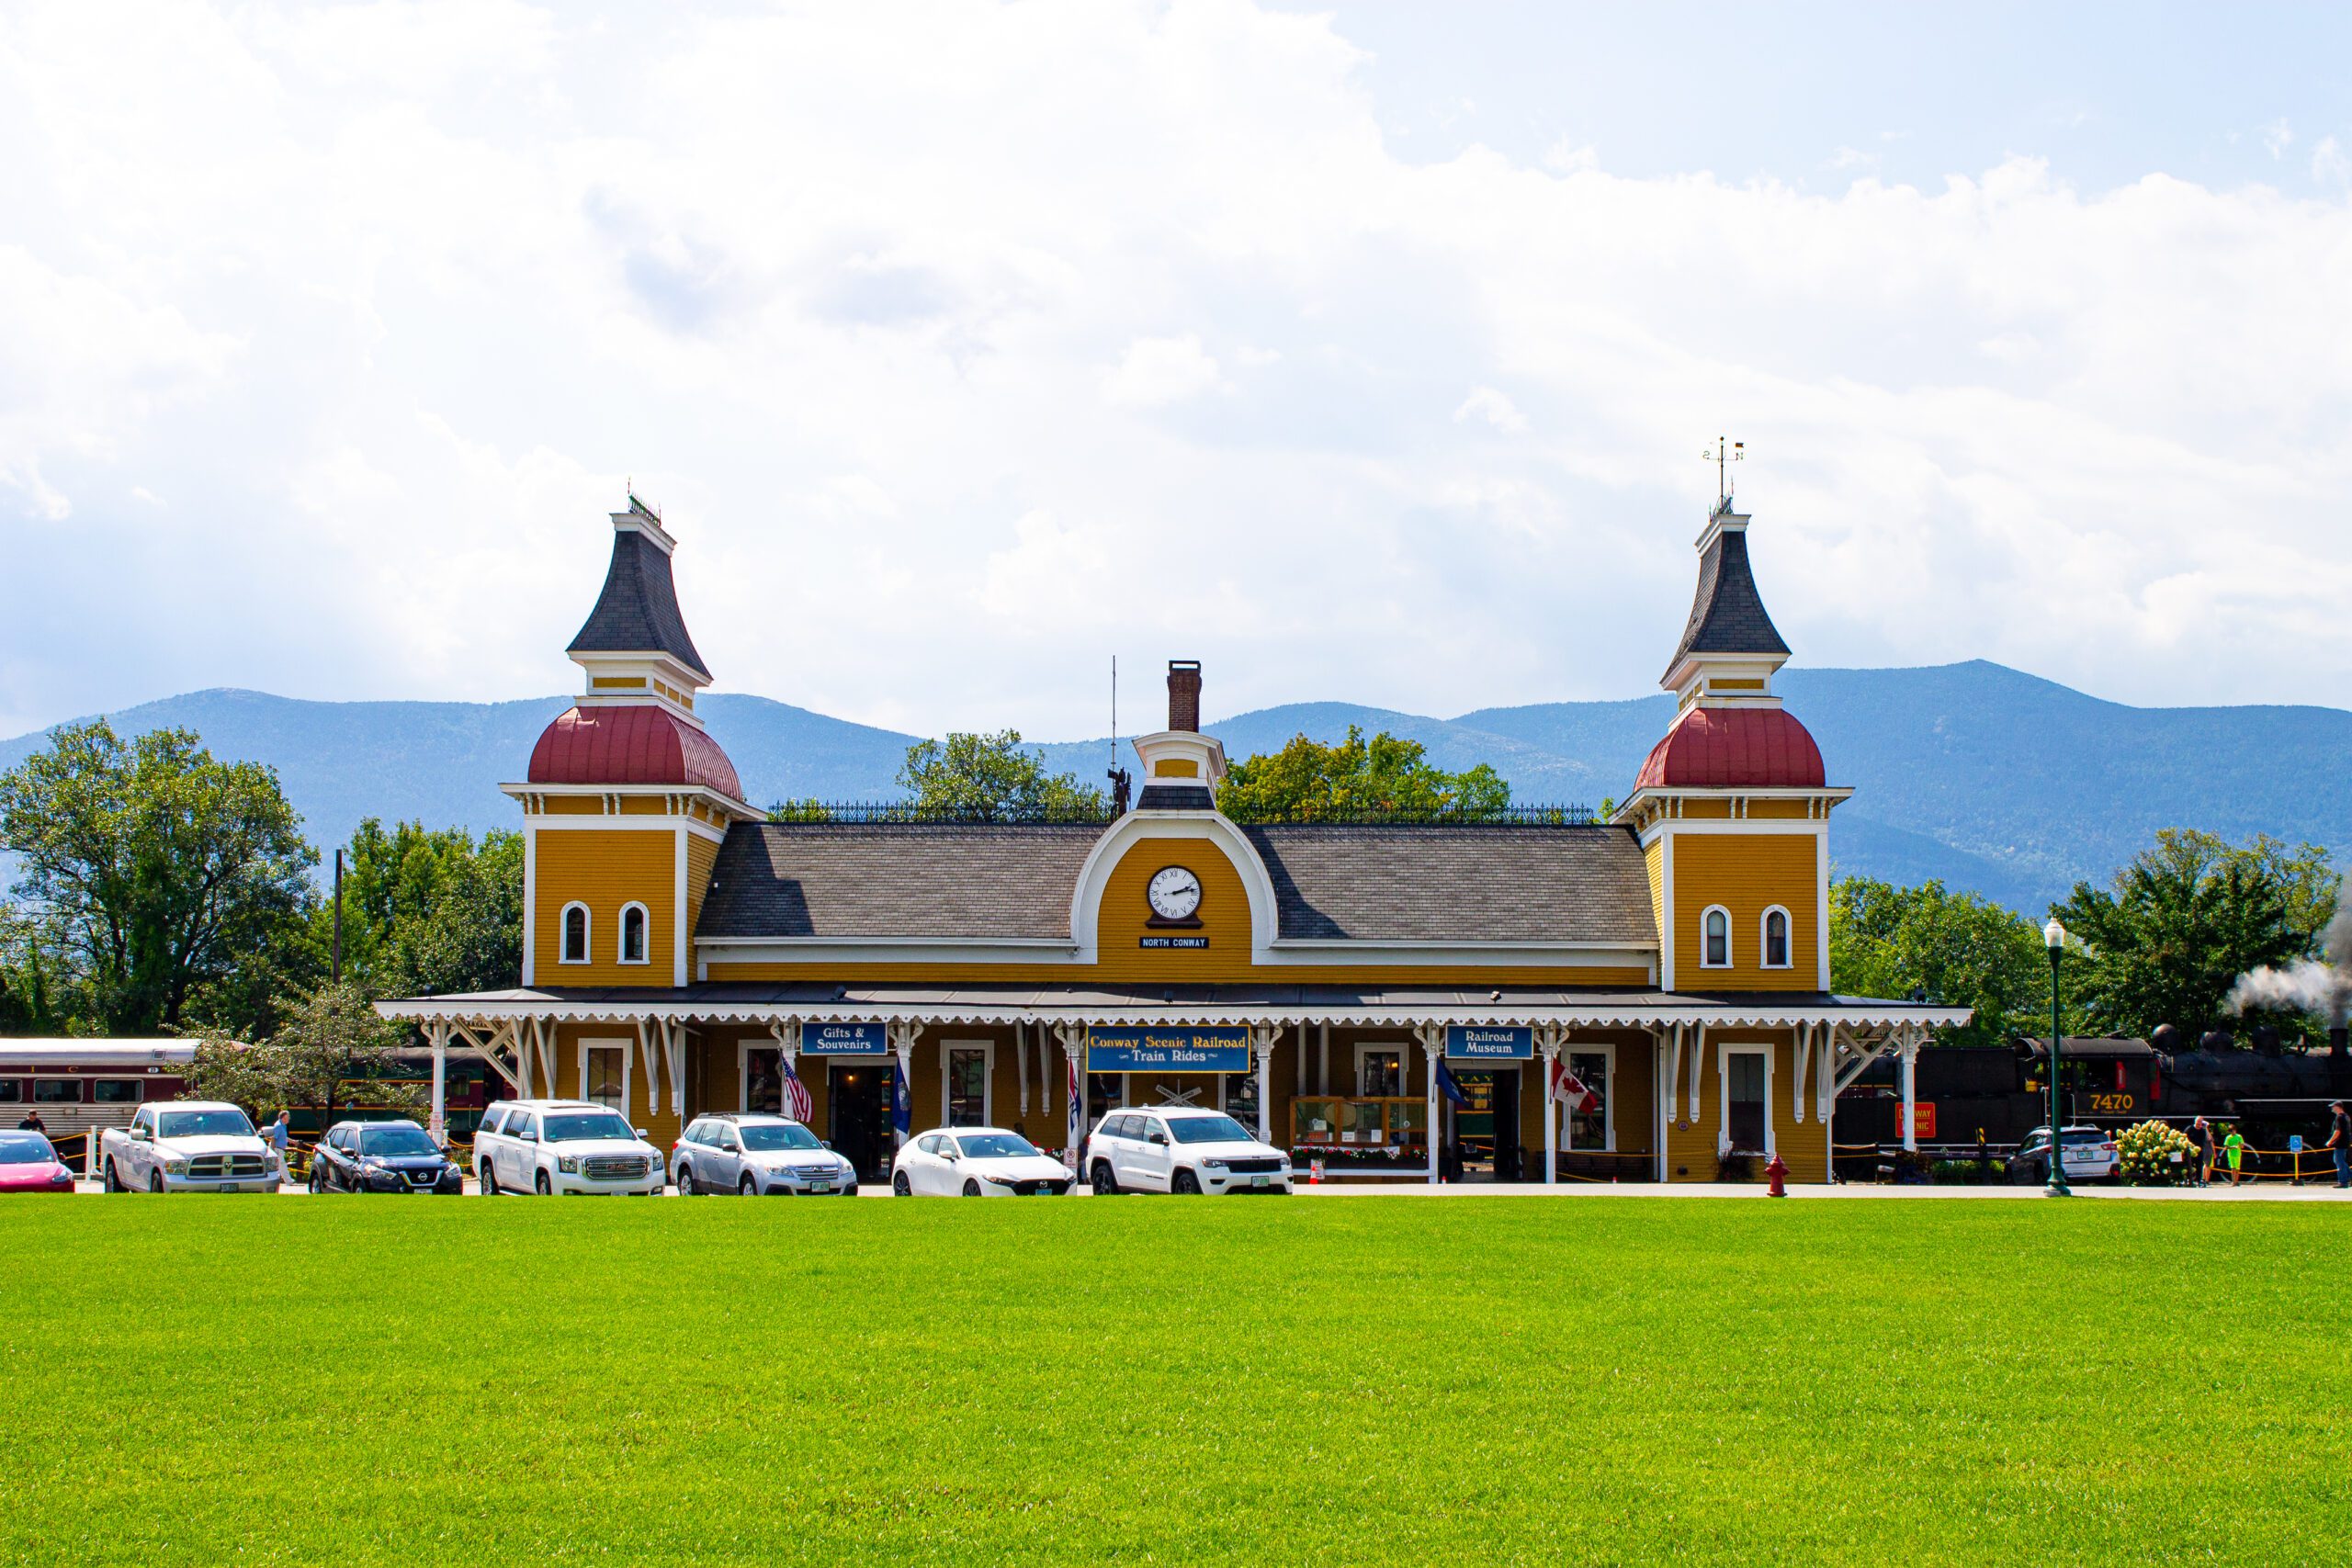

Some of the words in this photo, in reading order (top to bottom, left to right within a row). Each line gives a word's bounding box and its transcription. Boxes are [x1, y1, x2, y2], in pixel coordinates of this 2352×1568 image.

[1143, 939, 1169, 947] NORTH
[1173, 939, 1205, 947] CONWAY
[823, 1027, 851, 1038] Gifts
[855, 1027, 865, 1038] &
[1465, 1031, 1513, 1042] Railroad
[817, 1039, 871, 1049] Souvenirs
[1090, 1035, 1139, 1049] Conway
[1145, 1035, 1186, 1048] Scenic
[1193, 1036, 1246, 1048] Railroad
[1465, 1042, 1513, 1053] Museum
[1131, 1049, 1166, 1061] Train
[1171, 1049, 1206, 1061] Rides
[2090, 1095, 2132, 1110] 7470
[1899, 1109, 1931, 1119] CWAY
